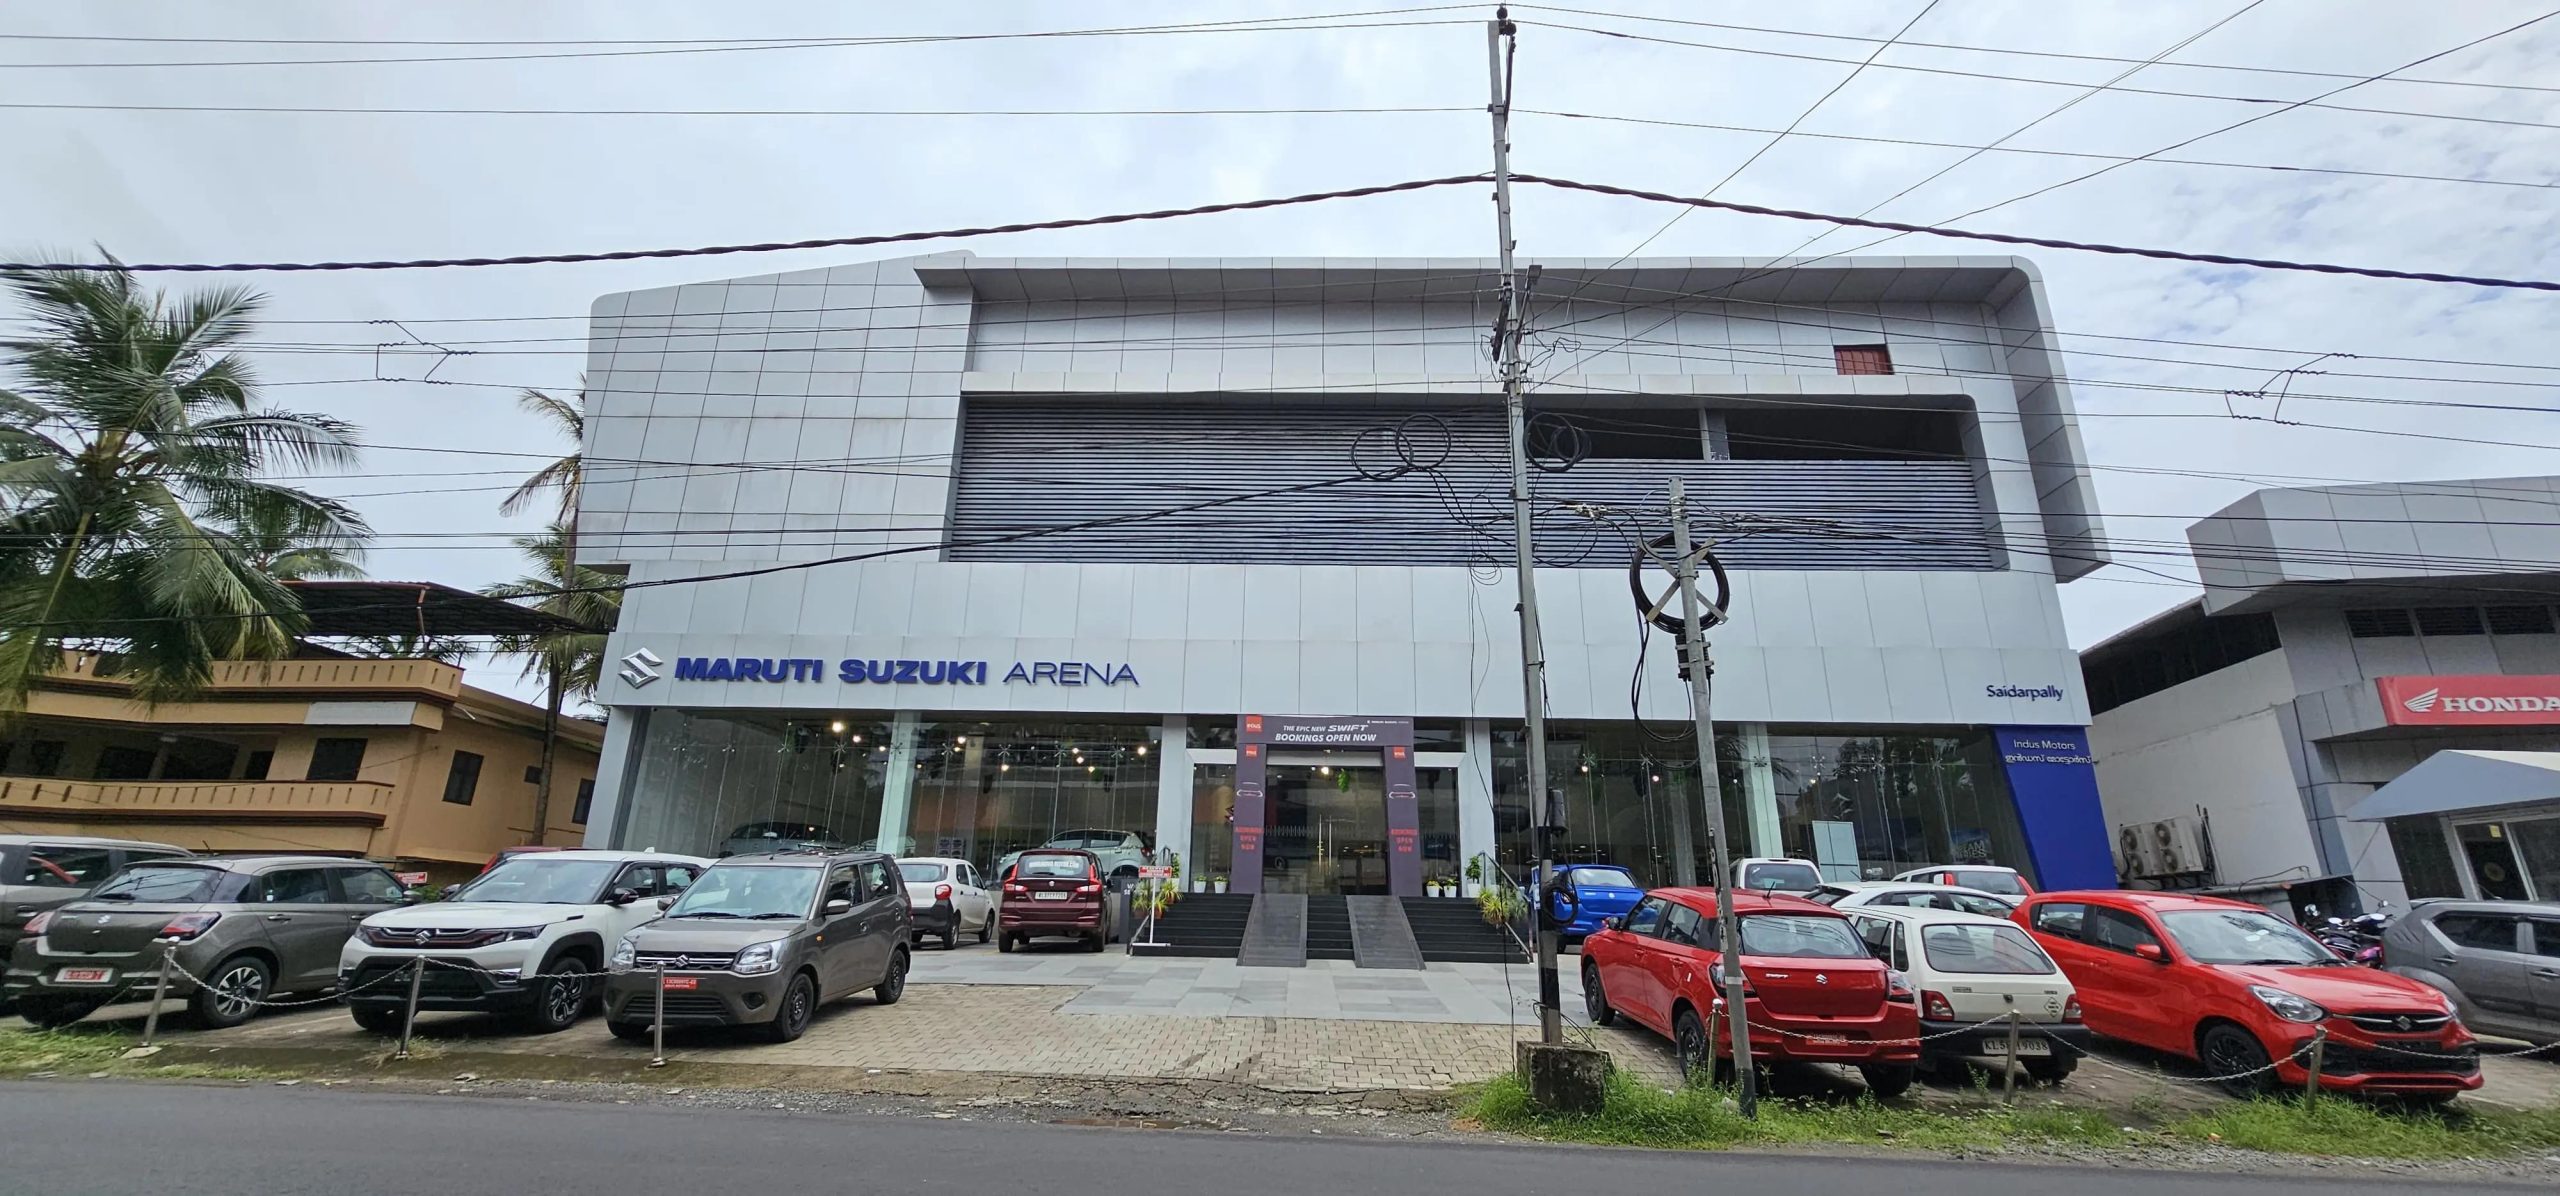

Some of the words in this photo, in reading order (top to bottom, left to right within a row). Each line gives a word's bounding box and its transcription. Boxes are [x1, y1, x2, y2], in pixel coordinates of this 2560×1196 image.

[674, 656, 823, 683] MARUTI
[838, 658, 987, 685] SUZUKI
[1003, 662, 1139, 686] ARENA
[1986, 684, 2064, 701] Saidarpally
[2440, 696, 2560, 712] HONDA
[1327, 724, 1369, 732] SWIFT
[1275, 733, 1323, 742] BOOKINGS
[1326, 734, 1350, 742] OPEN
[1353, 734, 1376, 742] NOW
[2013, 740, 2040, 749] Indus
[2042, 740, 2076, 750] Motors
